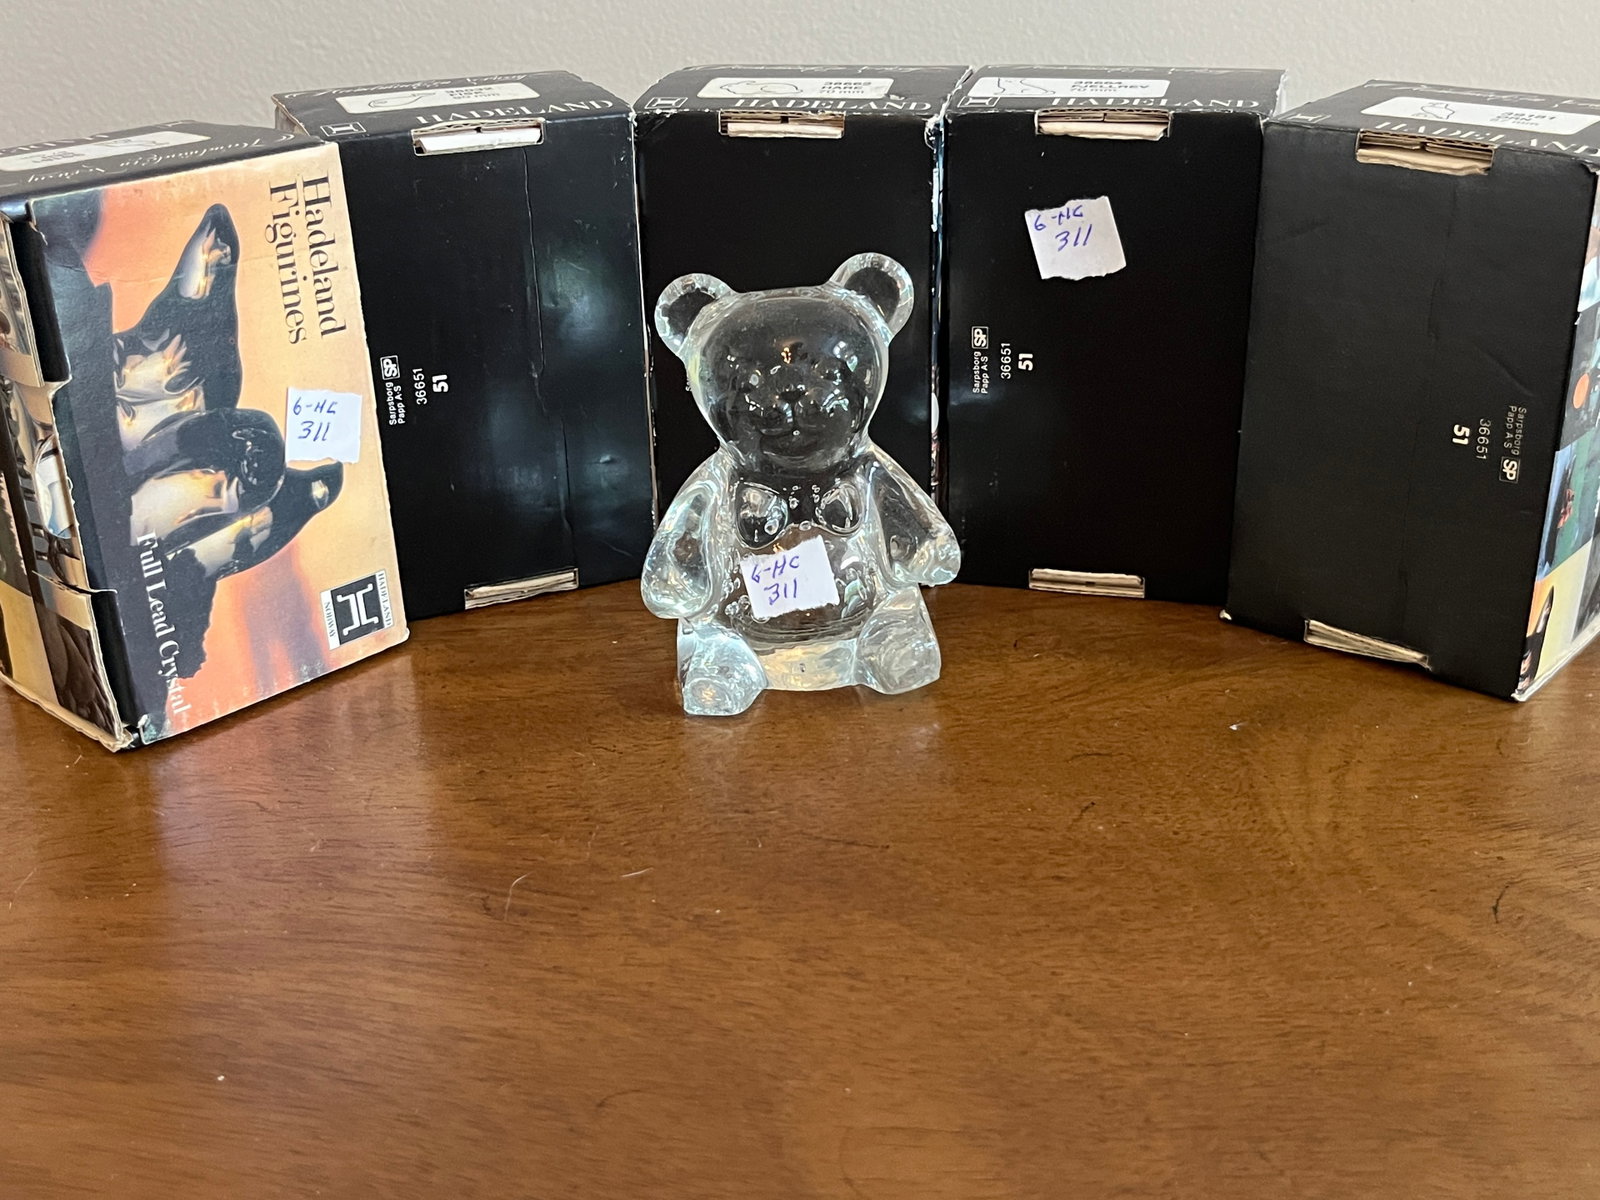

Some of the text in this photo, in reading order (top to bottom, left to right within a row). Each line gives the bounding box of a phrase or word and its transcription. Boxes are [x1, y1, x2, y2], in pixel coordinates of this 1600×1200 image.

[415, 99, 614, 125] HADELAND
[734, 98, 932, 112] HADELAND
[1051, 97, 1262, 109] HADELAND
[1055, 224, 1093, 252] 311
[264, 179, 307, 345] Figurines
[301, 174, 347, 338] Hadeland
[972, 328, 988, 393] Sarpsborg SP
[1001, 342, 1012, 380] 36651
[1018, 352, 1034, 372] 51
[382, 358, 398, 425] Sarpsborg SP
[413, 368, 427, 404] 36651
[432, 374, 448, 393] 51
[981, 373, 989, 394] Papp
[397, 402, 405, 424] Papp
[1505, 405, 1517, 429] Papp
[298, 420, 331, 442] 311
[1452, 424, 1470, 445] 51
[1475, 418, 1491, 460] 36651
[1502, 407, 1527, 481] Sarpsborg SP
[378, 572, 392, 626] HADELAND
[763, 578, 798, 606] 311
[136, 530, 192, 715] Full Lead Crystal
[324, 601, 336, 637] NORWAY
